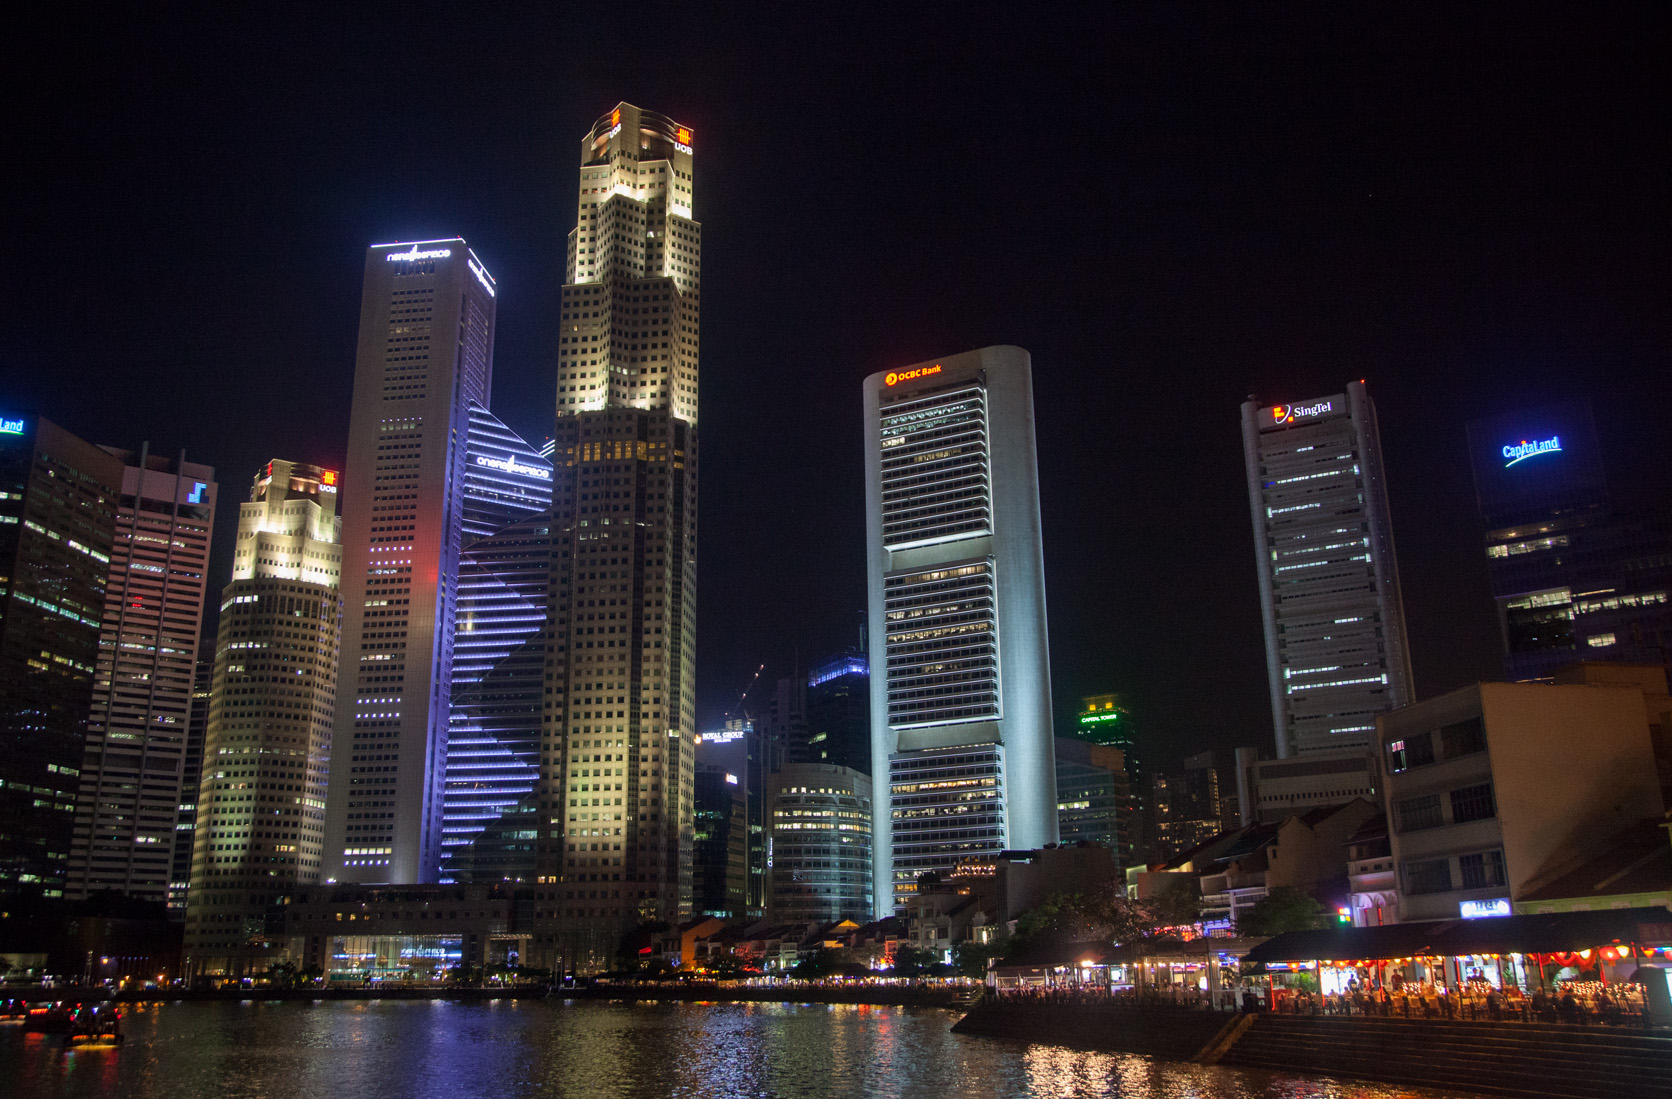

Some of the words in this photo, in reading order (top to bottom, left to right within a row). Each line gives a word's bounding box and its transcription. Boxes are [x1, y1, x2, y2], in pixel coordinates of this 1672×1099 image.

[675, 142, 693, 155] UOB
[898, 369, 921, 381] OCBC
[922, 364, 942, 376] Bank
[1294, 401, 1332, 417] SingTel
[1503, 436, 1560, 458] CapitaLand
[319, 483, 337, 494] UOB
